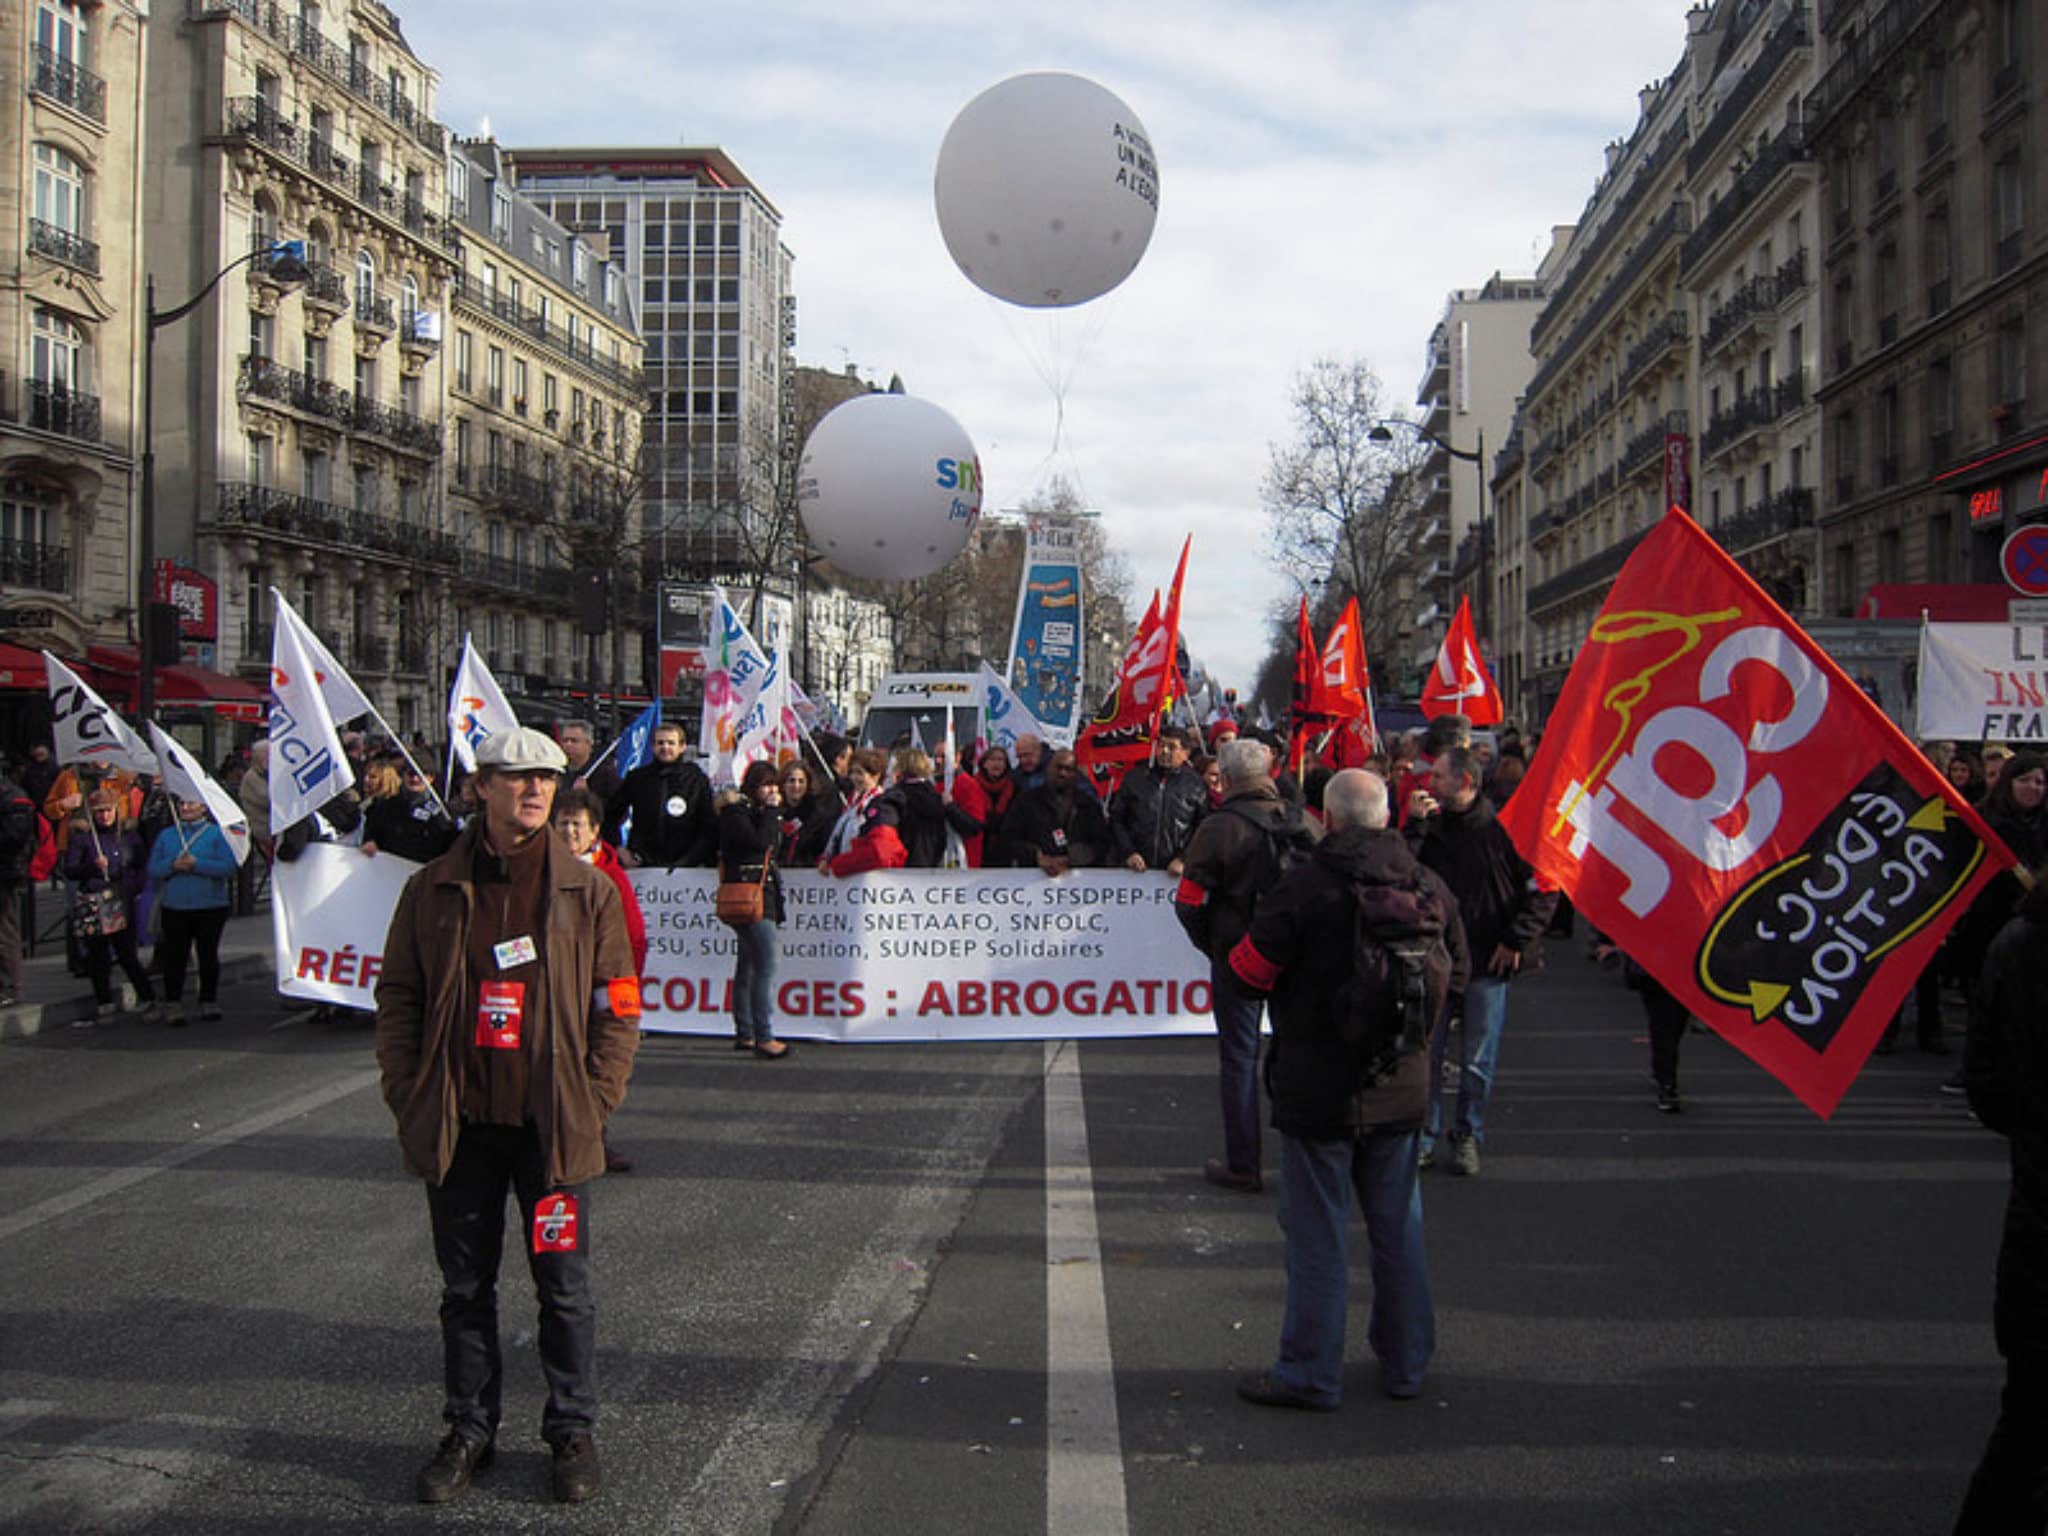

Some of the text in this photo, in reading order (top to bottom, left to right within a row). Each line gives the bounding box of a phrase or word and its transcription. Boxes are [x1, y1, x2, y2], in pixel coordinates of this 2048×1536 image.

[847, 888, 914, 905] CNGA
[925, 888, 967, 905] CFE
[977, 888, 1032, 908] CGC,
[795, 914, 853, 934] FAEN,
[864, 913, 1000, 934] SNETAAFO,
[1010, 913, 1110, 934] SNFOLC,
[880, 940, 977, 958] SUNDEP
[986, 938, 1104, 958] Solidaires
